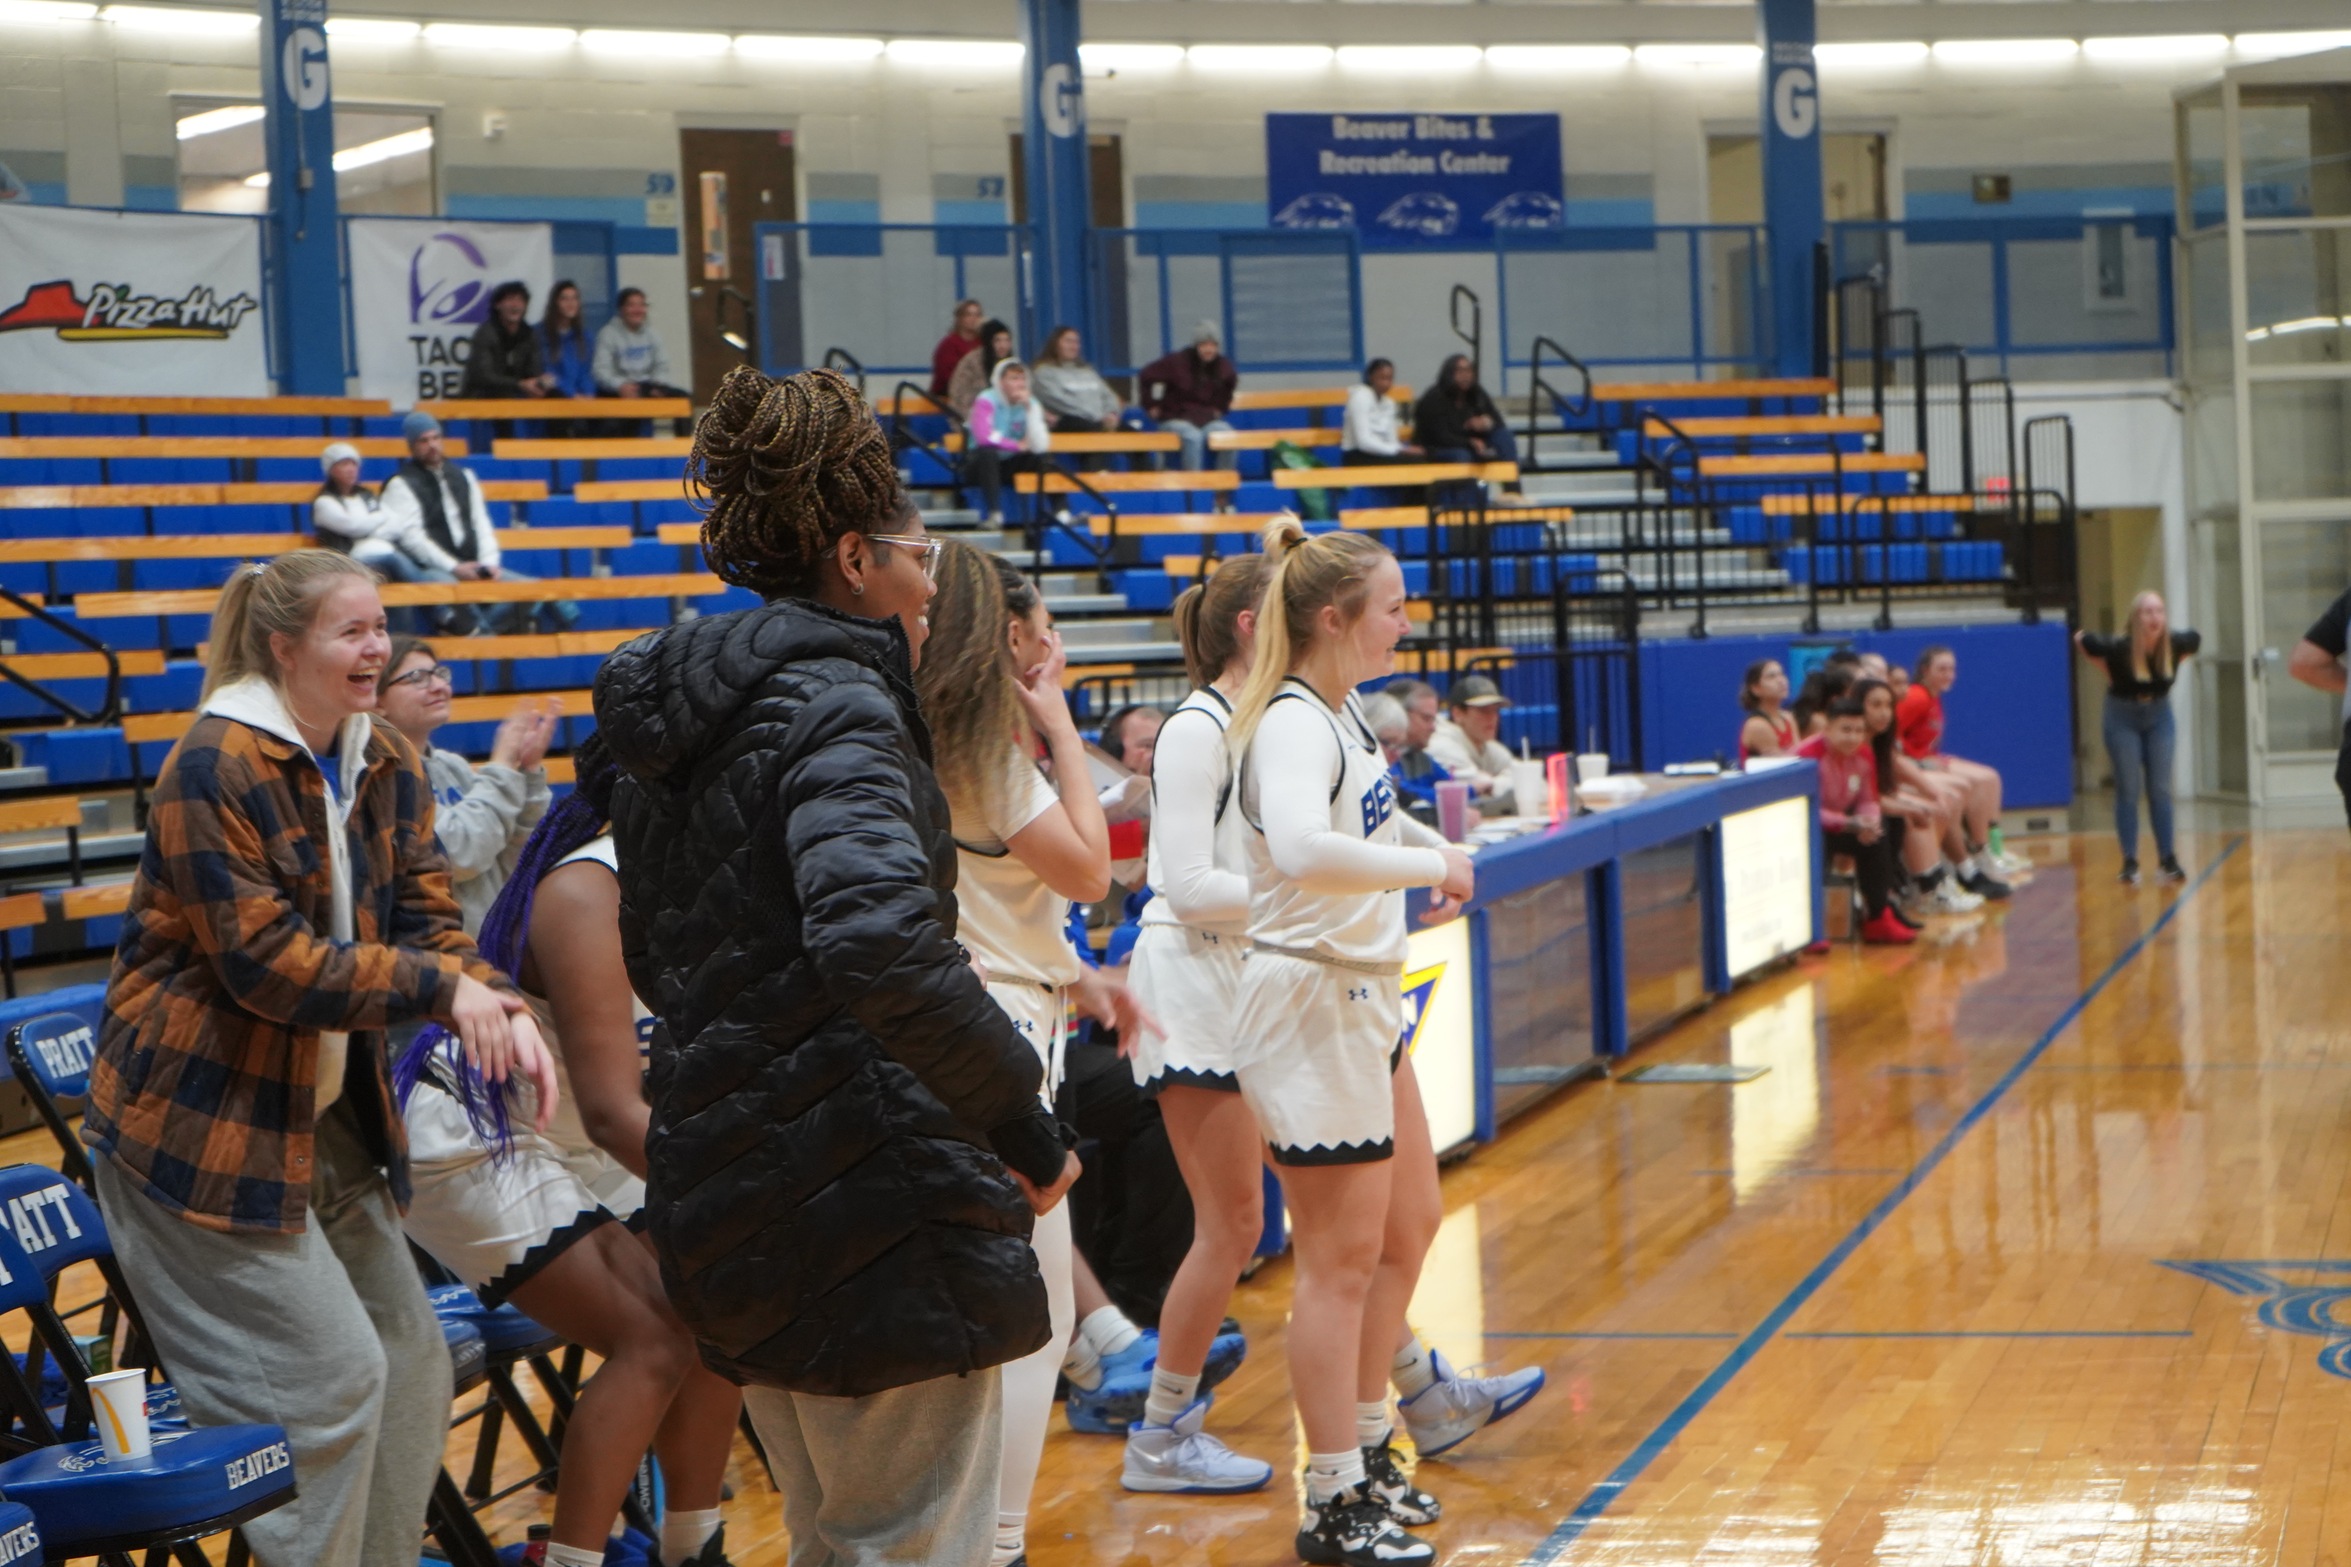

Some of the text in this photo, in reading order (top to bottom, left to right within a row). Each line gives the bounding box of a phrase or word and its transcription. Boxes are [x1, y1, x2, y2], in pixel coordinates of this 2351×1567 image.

[283, 27, 328, 111] G
[1040, 63, 1085, 138] G
[1773, 67, 1816, 139] G
[1438, 149, 1511, 174] Center
[81, 283, 254, 329] Pizza Hut
[408, 335, 474, 366] TAC
[418, 371, 464, 399] BE
[36, 1026, 96, 1079] PRATT
[0, 1183, 83, 1255] ATT
[224, 1441, 290, 1490] BEAVERS
[0, 1521, 40, 1566] AVERS
